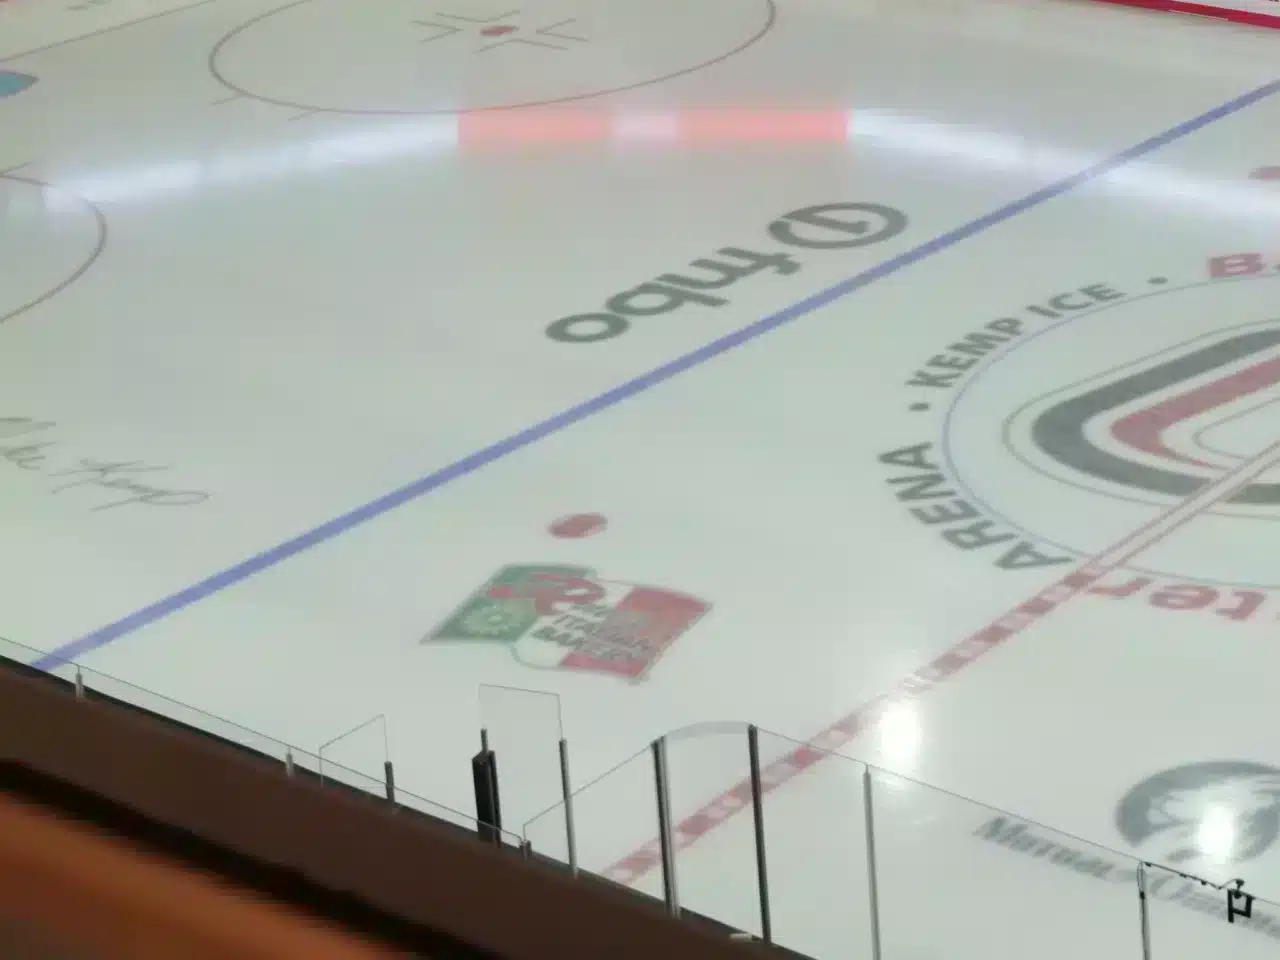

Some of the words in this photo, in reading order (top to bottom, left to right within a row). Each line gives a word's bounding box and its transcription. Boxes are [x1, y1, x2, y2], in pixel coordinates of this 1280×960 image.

[905, 317, 1025, 389] KEMP
[1025, 282, 1127, 319] ICE
[877, 441, 1077, 571] ARENA
